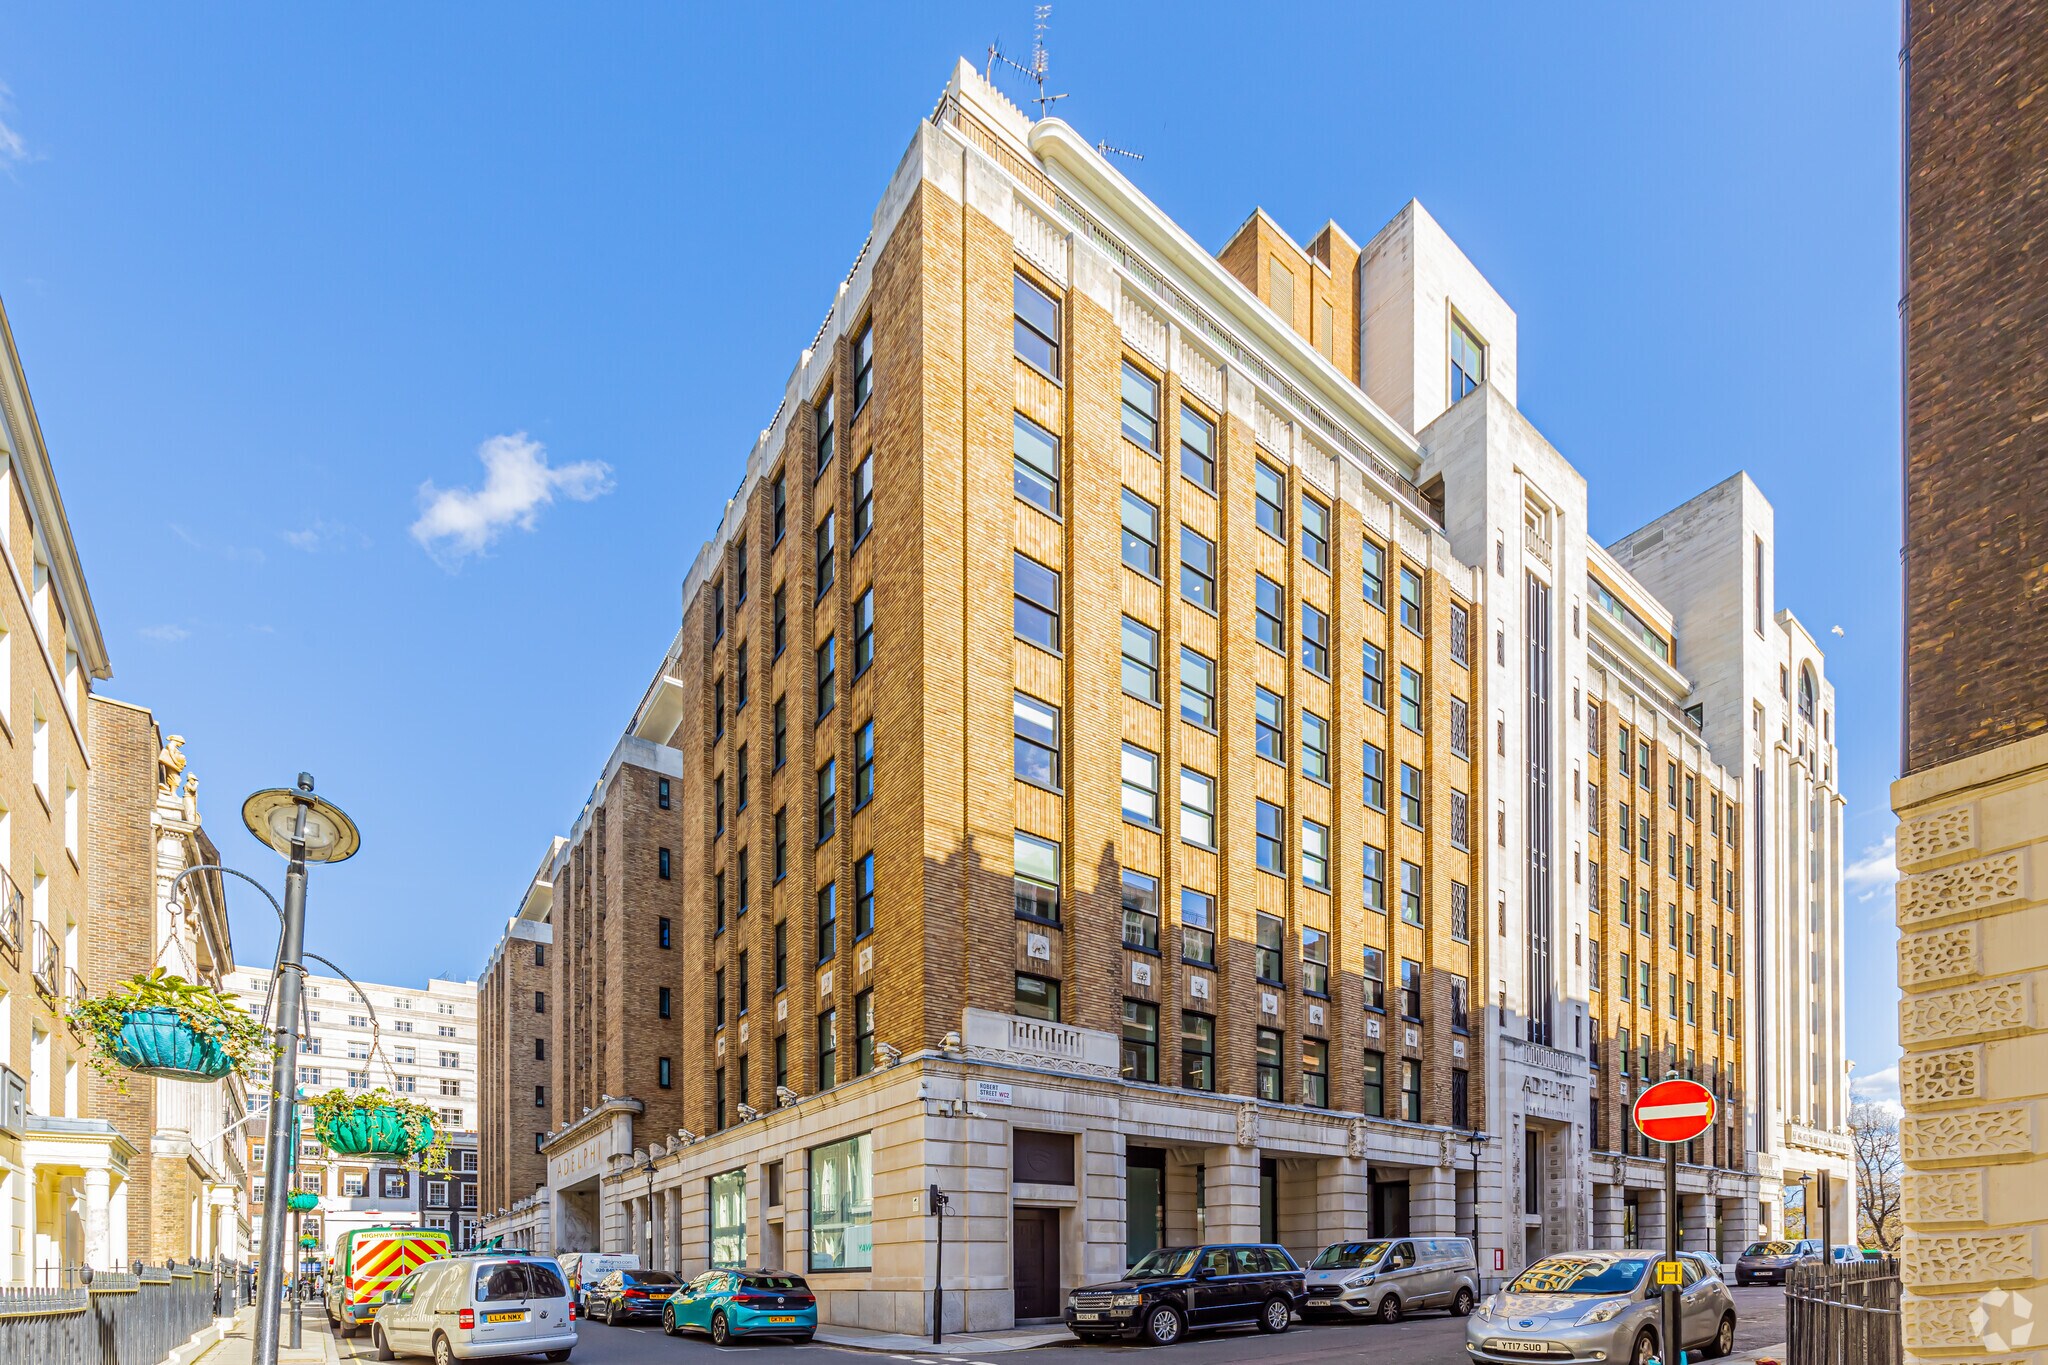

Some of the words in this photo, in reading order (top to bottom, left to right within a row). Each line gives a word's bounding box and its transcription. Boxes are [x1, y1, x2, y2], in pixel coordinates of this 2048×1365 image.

[1521, 1075, 1575, 1102] ADELPHI
[556, 1140, 601, 1179] ADELPHI
[489, 1313, 506, 1322] LL14
[507, 1312, 522, 1320] NMX
[1502, 1342, 1521, 1350] YT17
[1523, 1343, 1541, 1351] SUO
